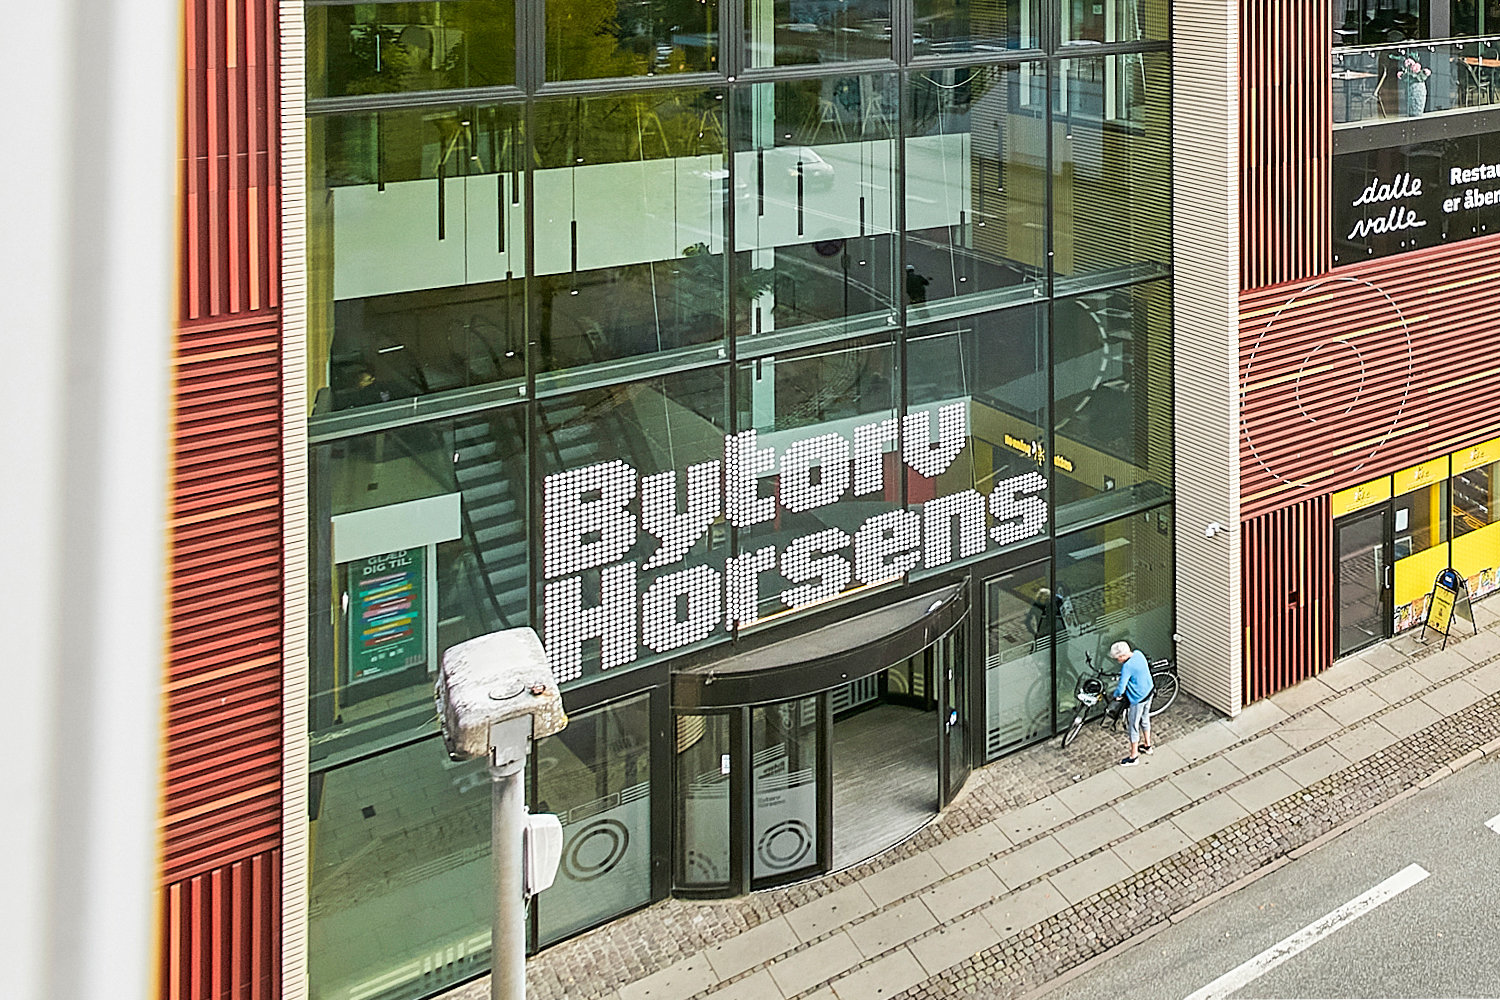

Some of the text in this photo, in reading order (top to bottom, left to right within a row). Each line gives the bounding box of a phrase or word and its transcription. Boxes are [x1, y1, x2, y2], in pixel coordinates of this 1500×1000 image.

[1352, 172, 1423, 207] dalle
[1442, 197, 1461, 213] er
[1347, 206, 1427, 240] valle
[544, 402, 966, 580] Bytorv
[363, 557, 412, 576] DIG TIL:
[368, 550, 407, 565] GLÆD
[545, 471, 1048, 685] Horsens
